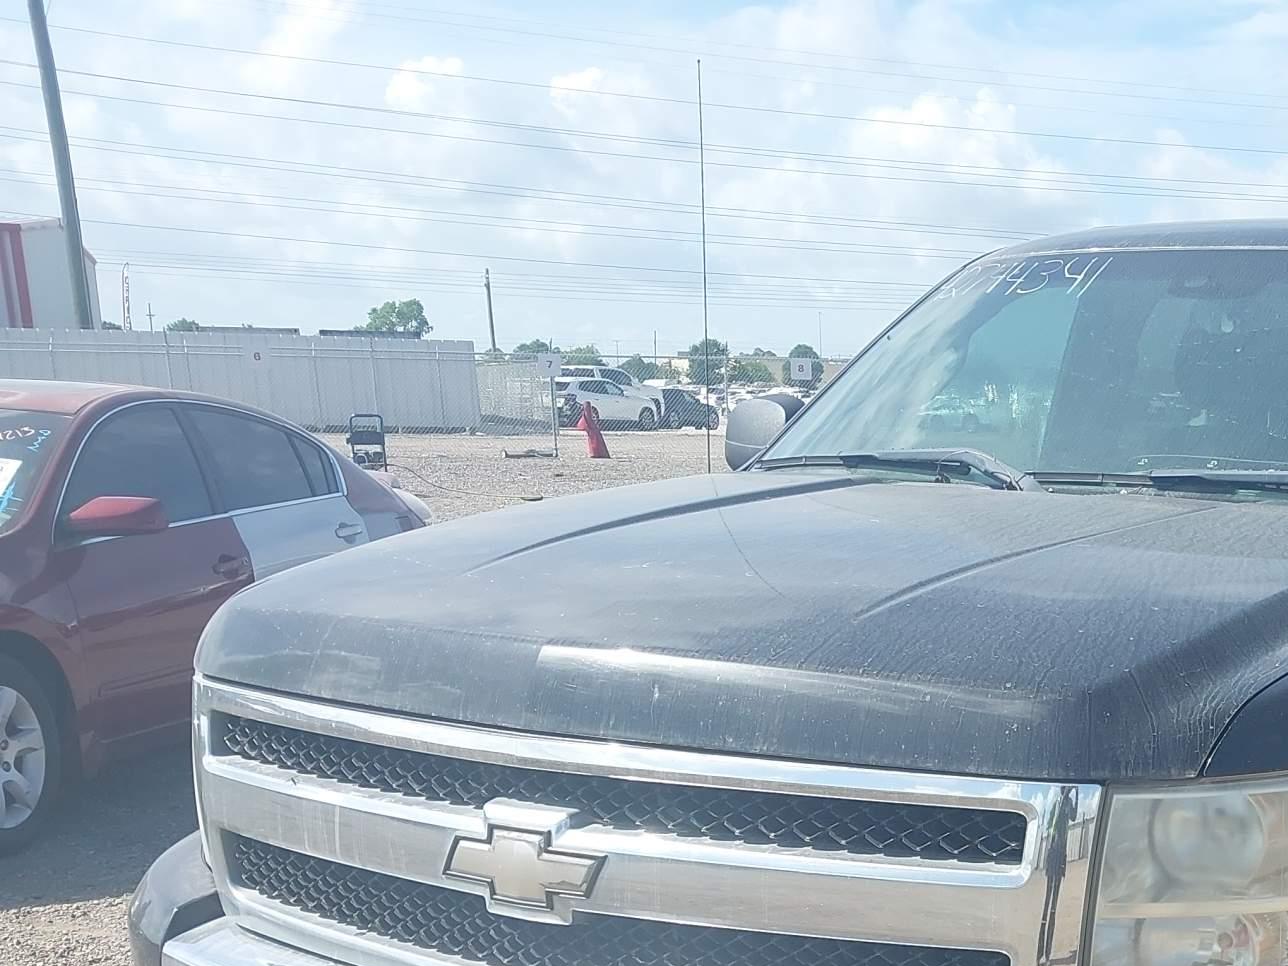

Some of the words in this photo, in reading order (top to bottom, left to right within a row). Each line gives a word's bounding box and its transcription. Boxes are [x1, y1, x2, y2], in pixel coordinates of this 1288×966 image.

[253, 352, 261, 361] 6
[545, 360, 553, 369] 7
[798, 364, 804, 373] 8
